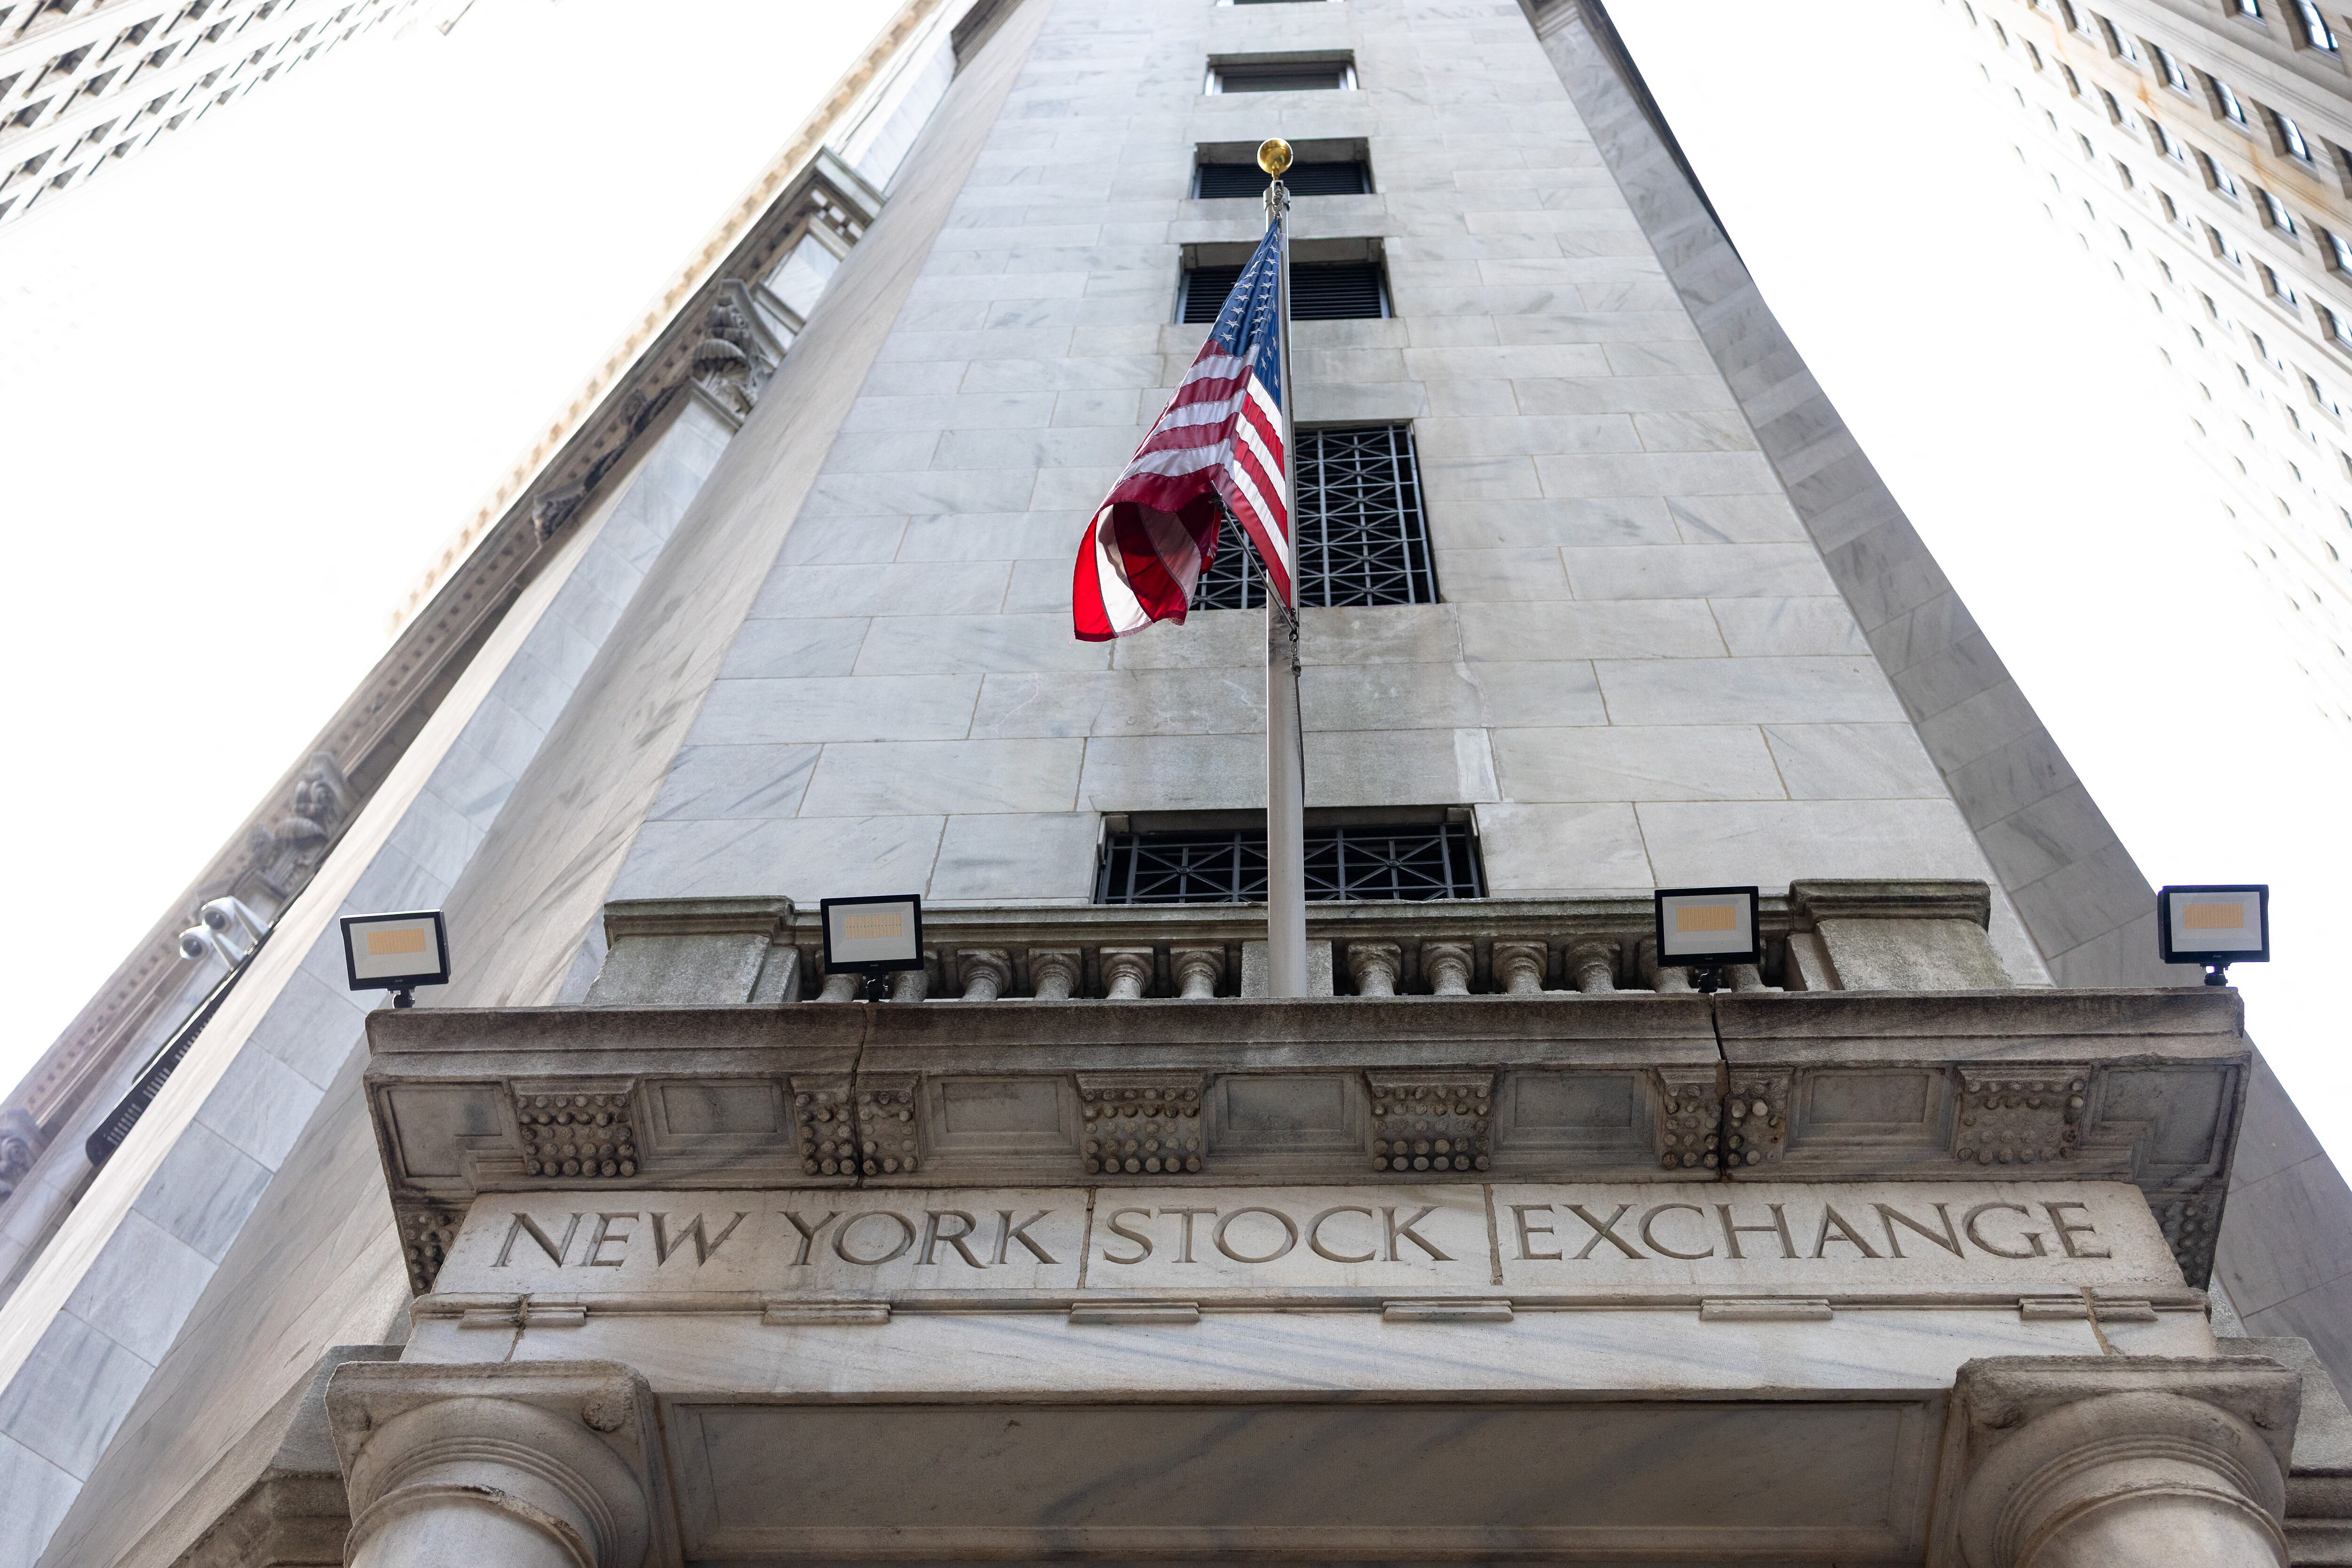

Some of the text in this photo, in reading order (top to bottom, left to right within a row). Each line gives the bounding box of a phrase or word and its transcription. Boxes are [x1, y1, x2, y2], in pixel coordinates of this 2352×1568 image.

[490, 1201, 2112, 1269] NEW YORK STOCK EXCHANGE
